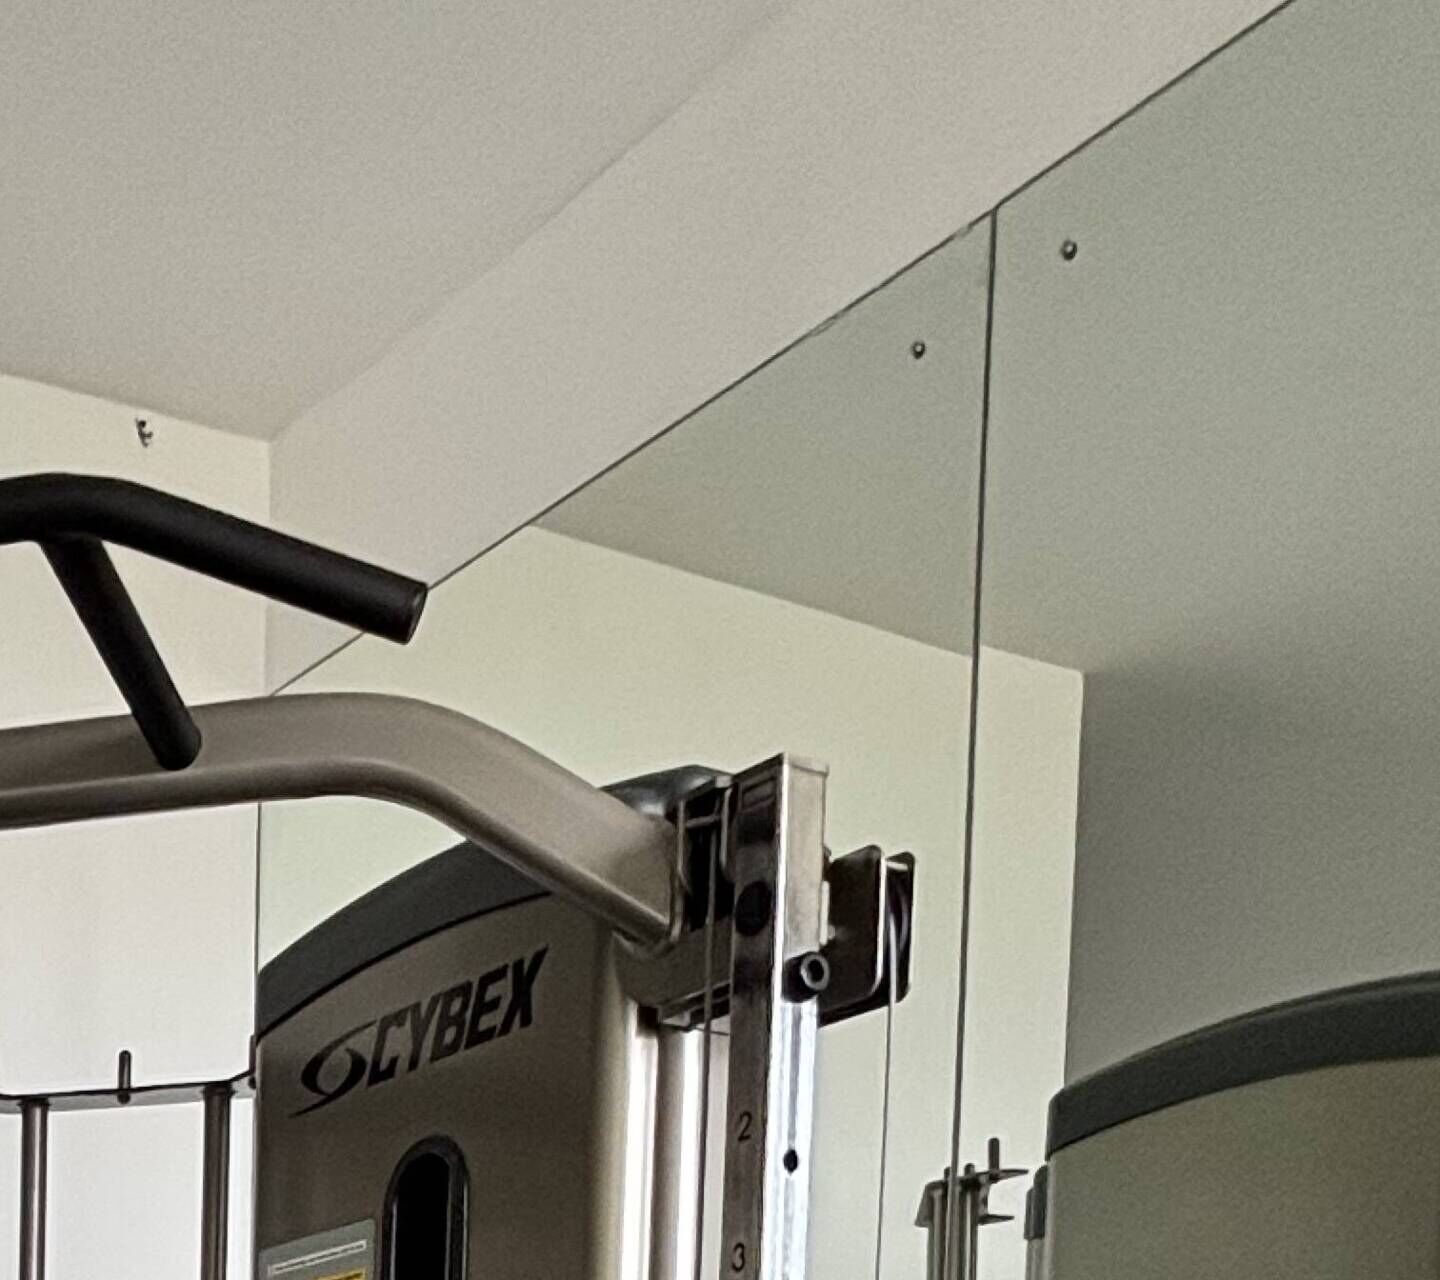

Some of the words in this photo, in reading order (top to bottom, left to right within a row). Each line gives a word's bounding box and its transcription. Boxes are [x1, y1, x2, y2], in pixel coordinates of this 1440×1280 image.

[367, 943, 549, 1088] CYBEX
[737, 1112, 753, 1142] 2
[731, 1243, 747, 1272] 3
